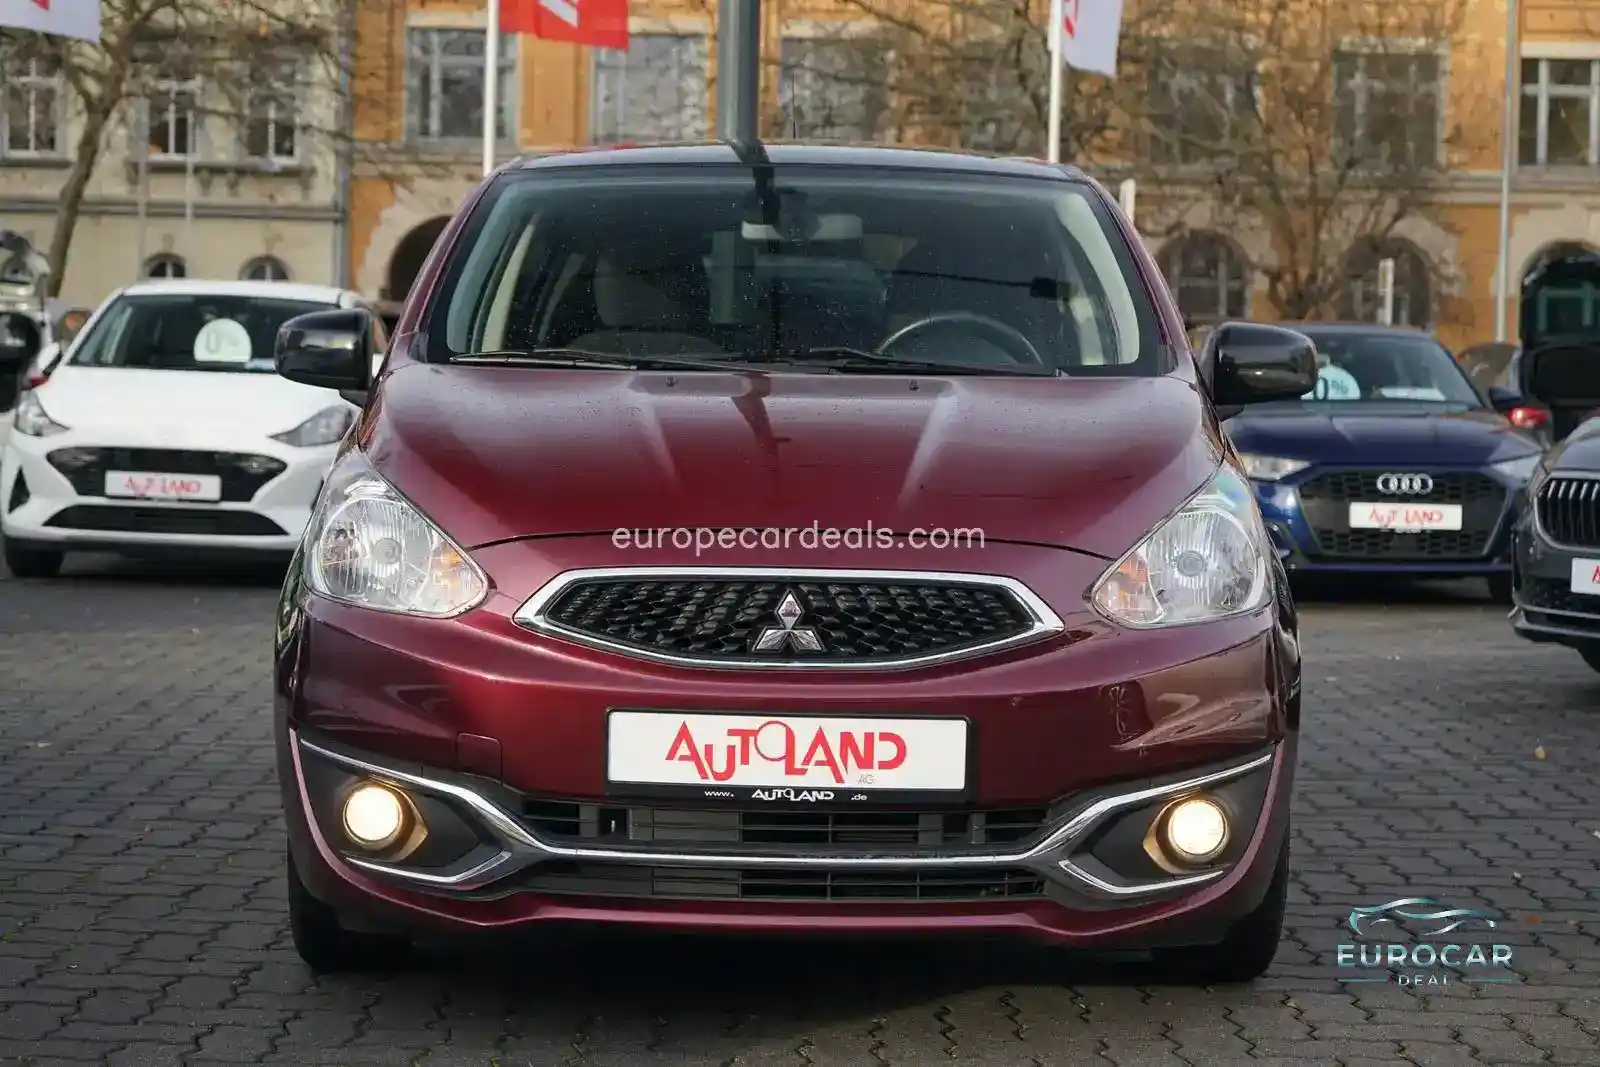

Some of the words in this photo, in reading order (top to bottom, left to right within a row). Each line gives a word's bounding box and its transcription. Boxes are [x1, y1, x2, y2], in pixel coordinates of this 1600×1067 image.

[124, 475, 202, 497] ATLAND
[1369, 504, 1444, 528] AUTLAND
[856, 774, 875, 785] AG
